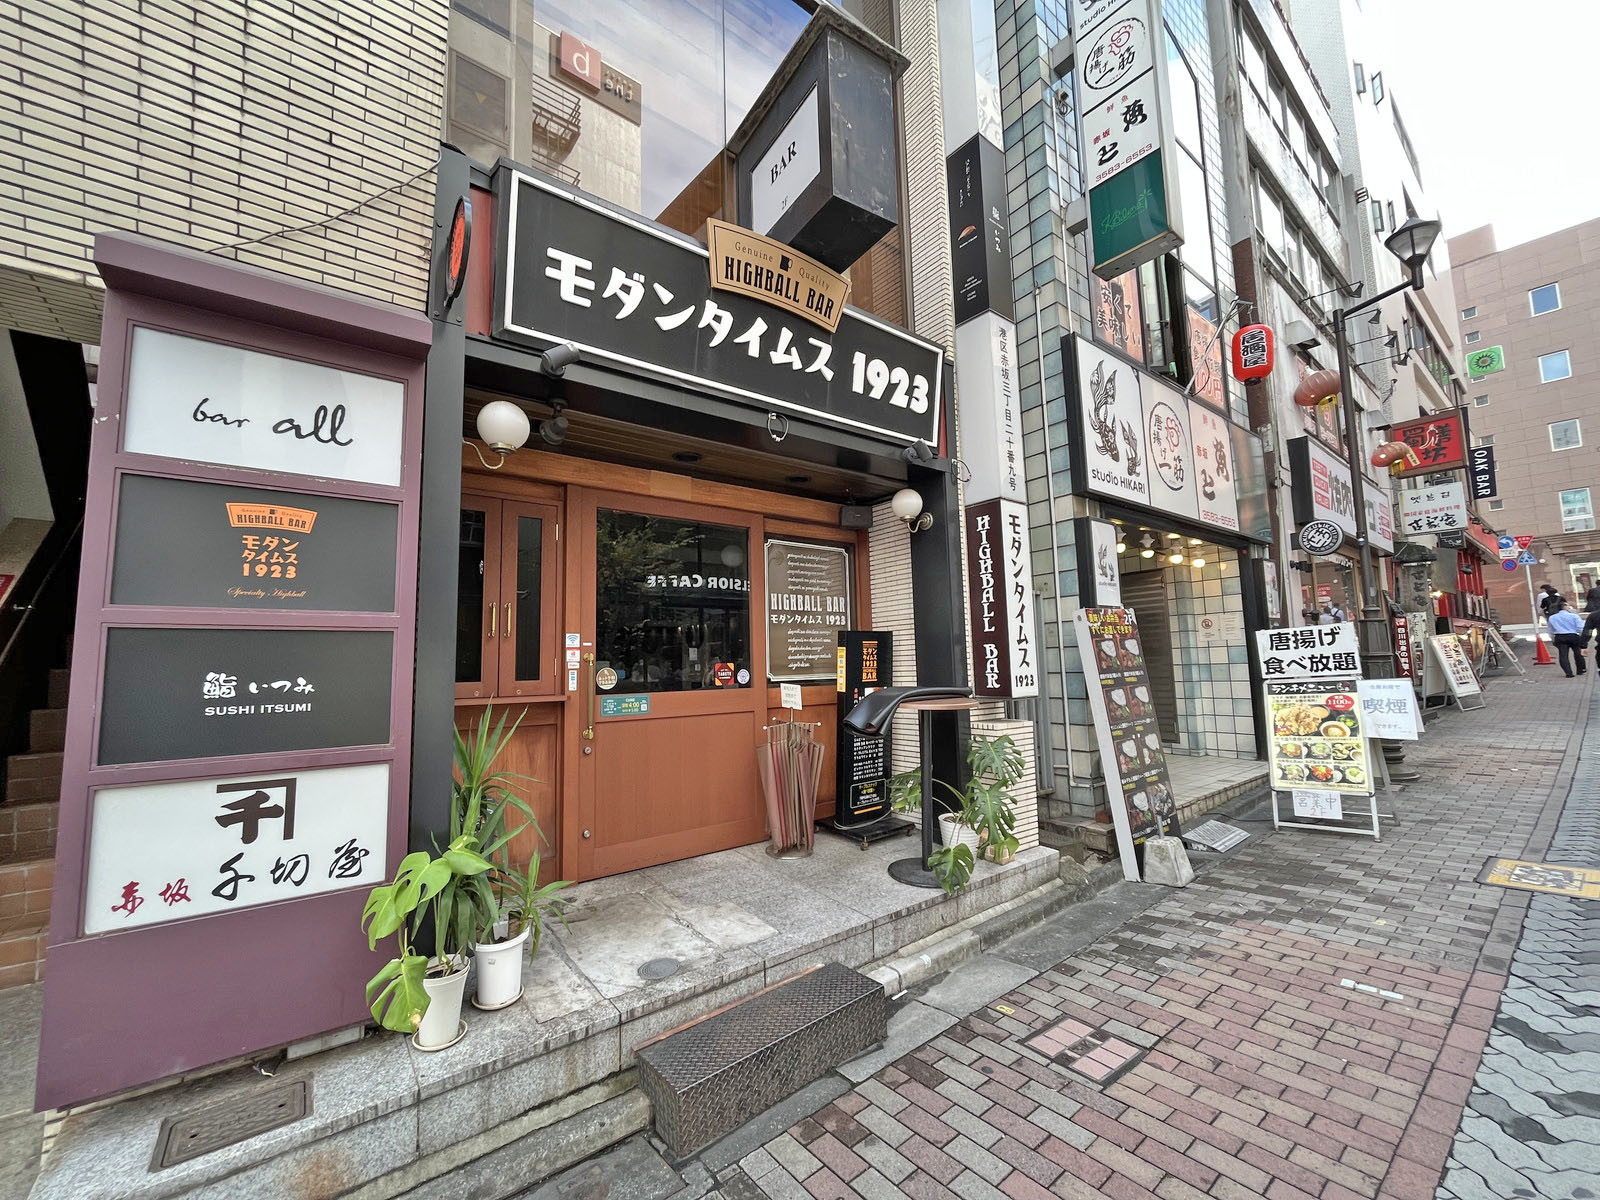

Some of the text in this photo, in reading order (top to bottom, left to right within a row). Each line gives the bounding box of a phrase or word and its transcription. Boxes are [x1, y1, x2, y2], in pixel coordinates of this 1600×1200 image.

[770, 141, 797, 185] BAR
[1095, 143, 1153, 183] 3583-6553
[734, 241, 831, 291] Genuine Quality
[724, 255, 835, 320] HIGHBALL BAR
[544, 246, 929, 415] モダンタイムス 1923
[1241, 328, 1268, 369] 居酒屋
[192, 397, 354, 447] bar all
[1091, 468, 1146, 495] studio HIKARI
[1474, 450, 1491, 496] OAK BAR
[237, 514, 307, 529] HIGHBALL BAR
[242, 535, 299, 552] モダン
[242, 549, 298, 564] タイムス
[242, 563, 297, 579] 1923
[770, 592, 846, 613] HIGHBALL BAR
[975, 514, 1001, 690] HIGHBALL BAR
[1008, 514, 1035, 689] モダンタイムス 1923
[770, 613, 846, 626] モダンタイムス 1923
[1124, 614, 1133, 625] 2F
[1269, 625, 1341, 651] 唐揚げ
[862, 671, 878, 680] BAR
[1263, 651, 1358, 675] 食べ放題
[203, 671, 316, 699] 鮨 いつみ
[1271, 683, 1336, 694] ランチメニュー
[204, 702, 312, 716] SUSHI ITSUMI
[1362, 697, 1409, 714] 喫煙
[1296, 792, 1337, 810] 営業中
[111, 878, 192, 918] 赤坂
